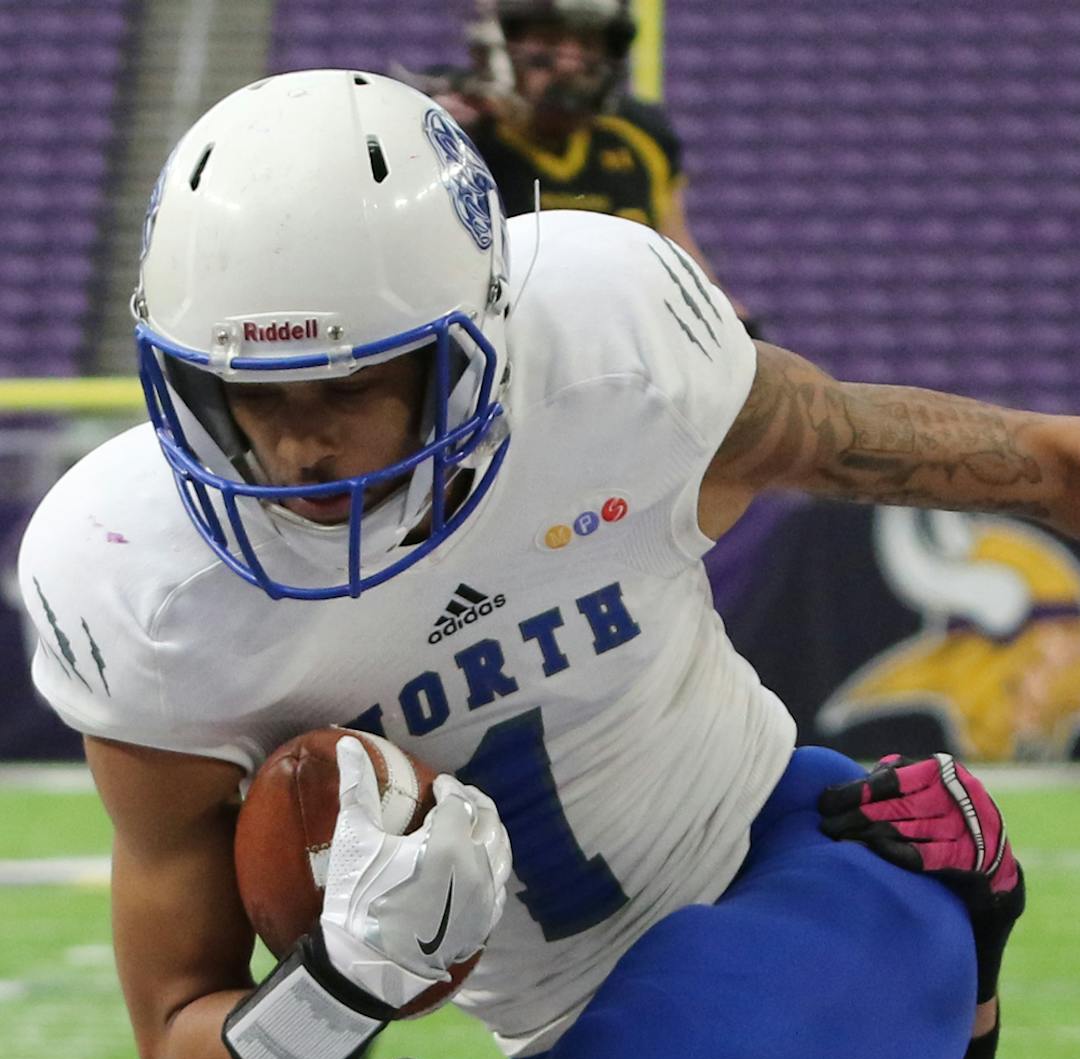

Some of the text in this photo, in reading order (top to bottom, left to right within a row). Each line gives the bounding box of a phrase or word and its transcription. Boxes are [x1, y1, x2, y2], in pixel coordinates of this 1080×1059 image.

[243, 319, 317, 342] Riddell
[428, 594, 506, 645] adidas
[455, 706, 631, 942] 1
